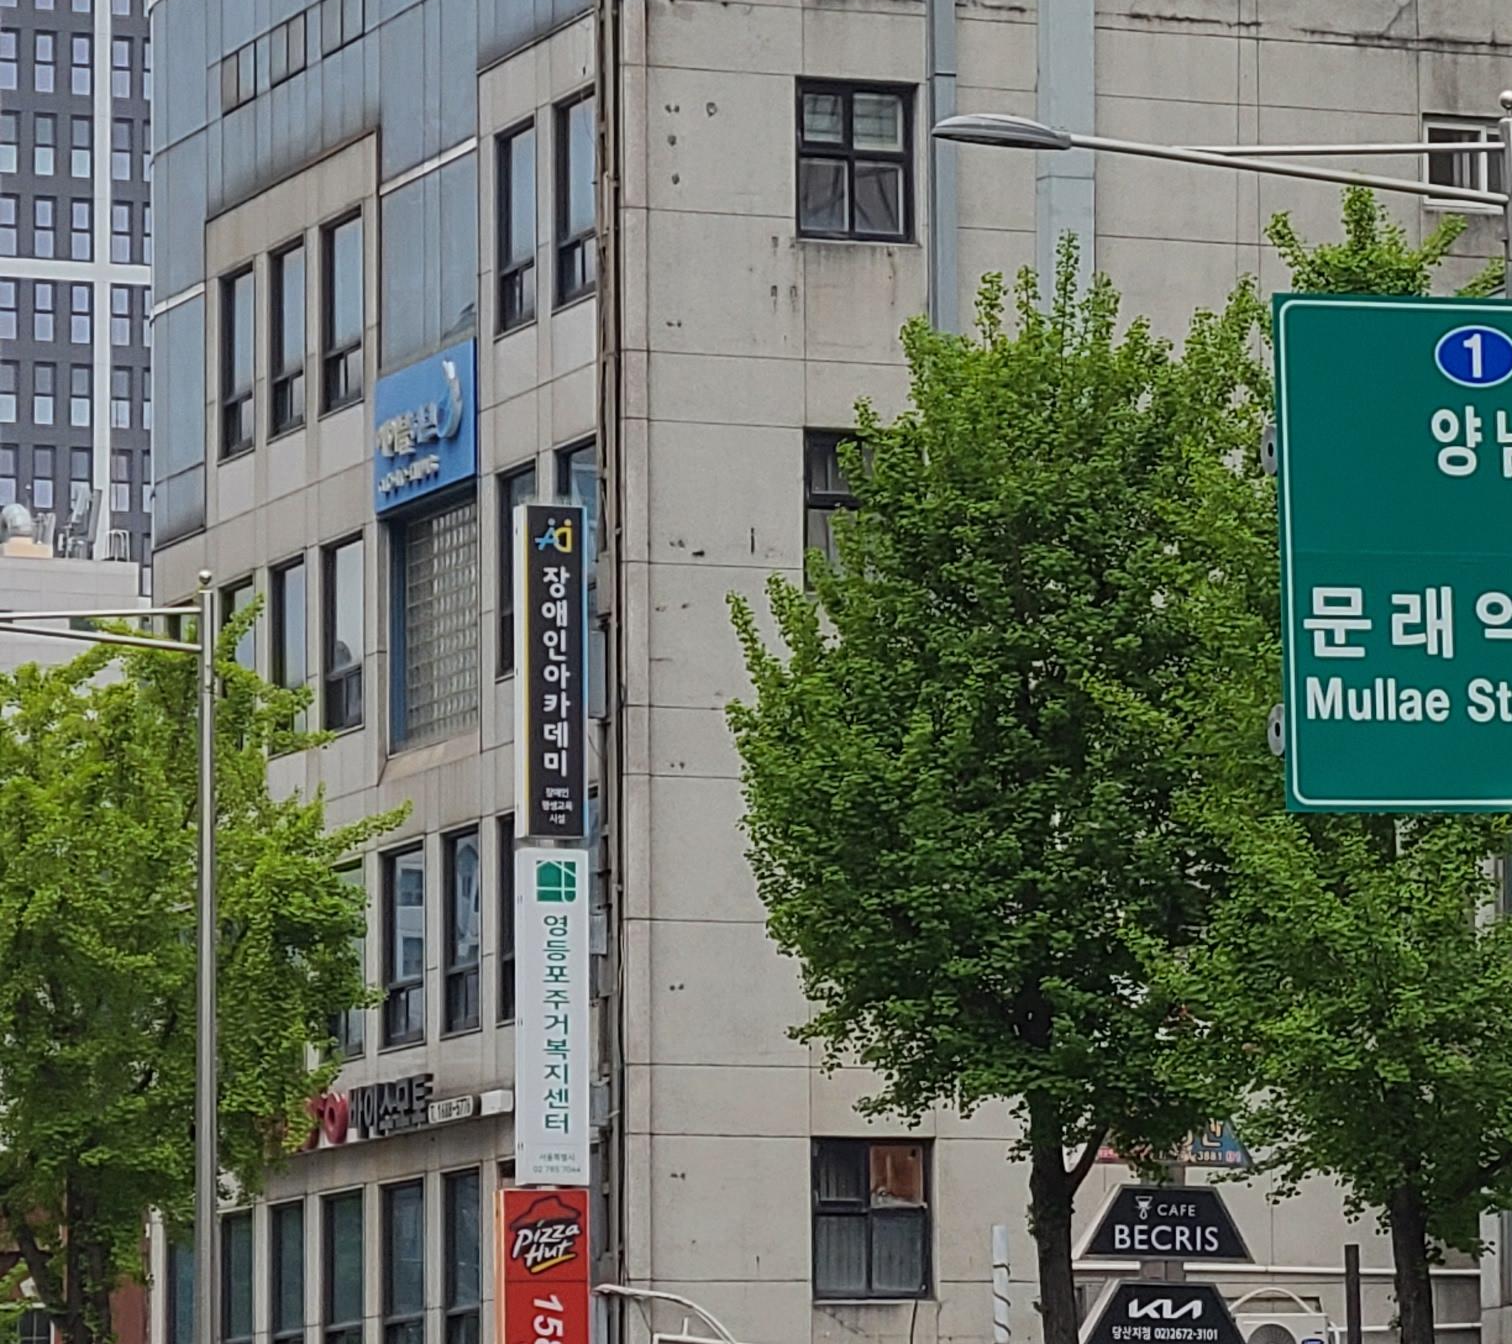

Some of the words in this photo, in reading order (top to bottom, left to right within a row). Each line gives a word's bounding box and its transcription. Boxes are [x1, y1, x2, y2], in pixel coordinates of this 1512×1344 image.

[1462, 333, 1483, 379] 1
[541, 565, 571, 778] 장애인아카데미
[1305, 676, 1451, 722] Mullae
[542, 914, 571, 1135] 영등포주거복지센터
[1156, 1204, 1196, 1217] CAFE
[512, 1218, 581, 1259] Pizza
[525, 1240, 575, 1268] Hut
[1113, 1224, 1219, 1252] BECRIS
